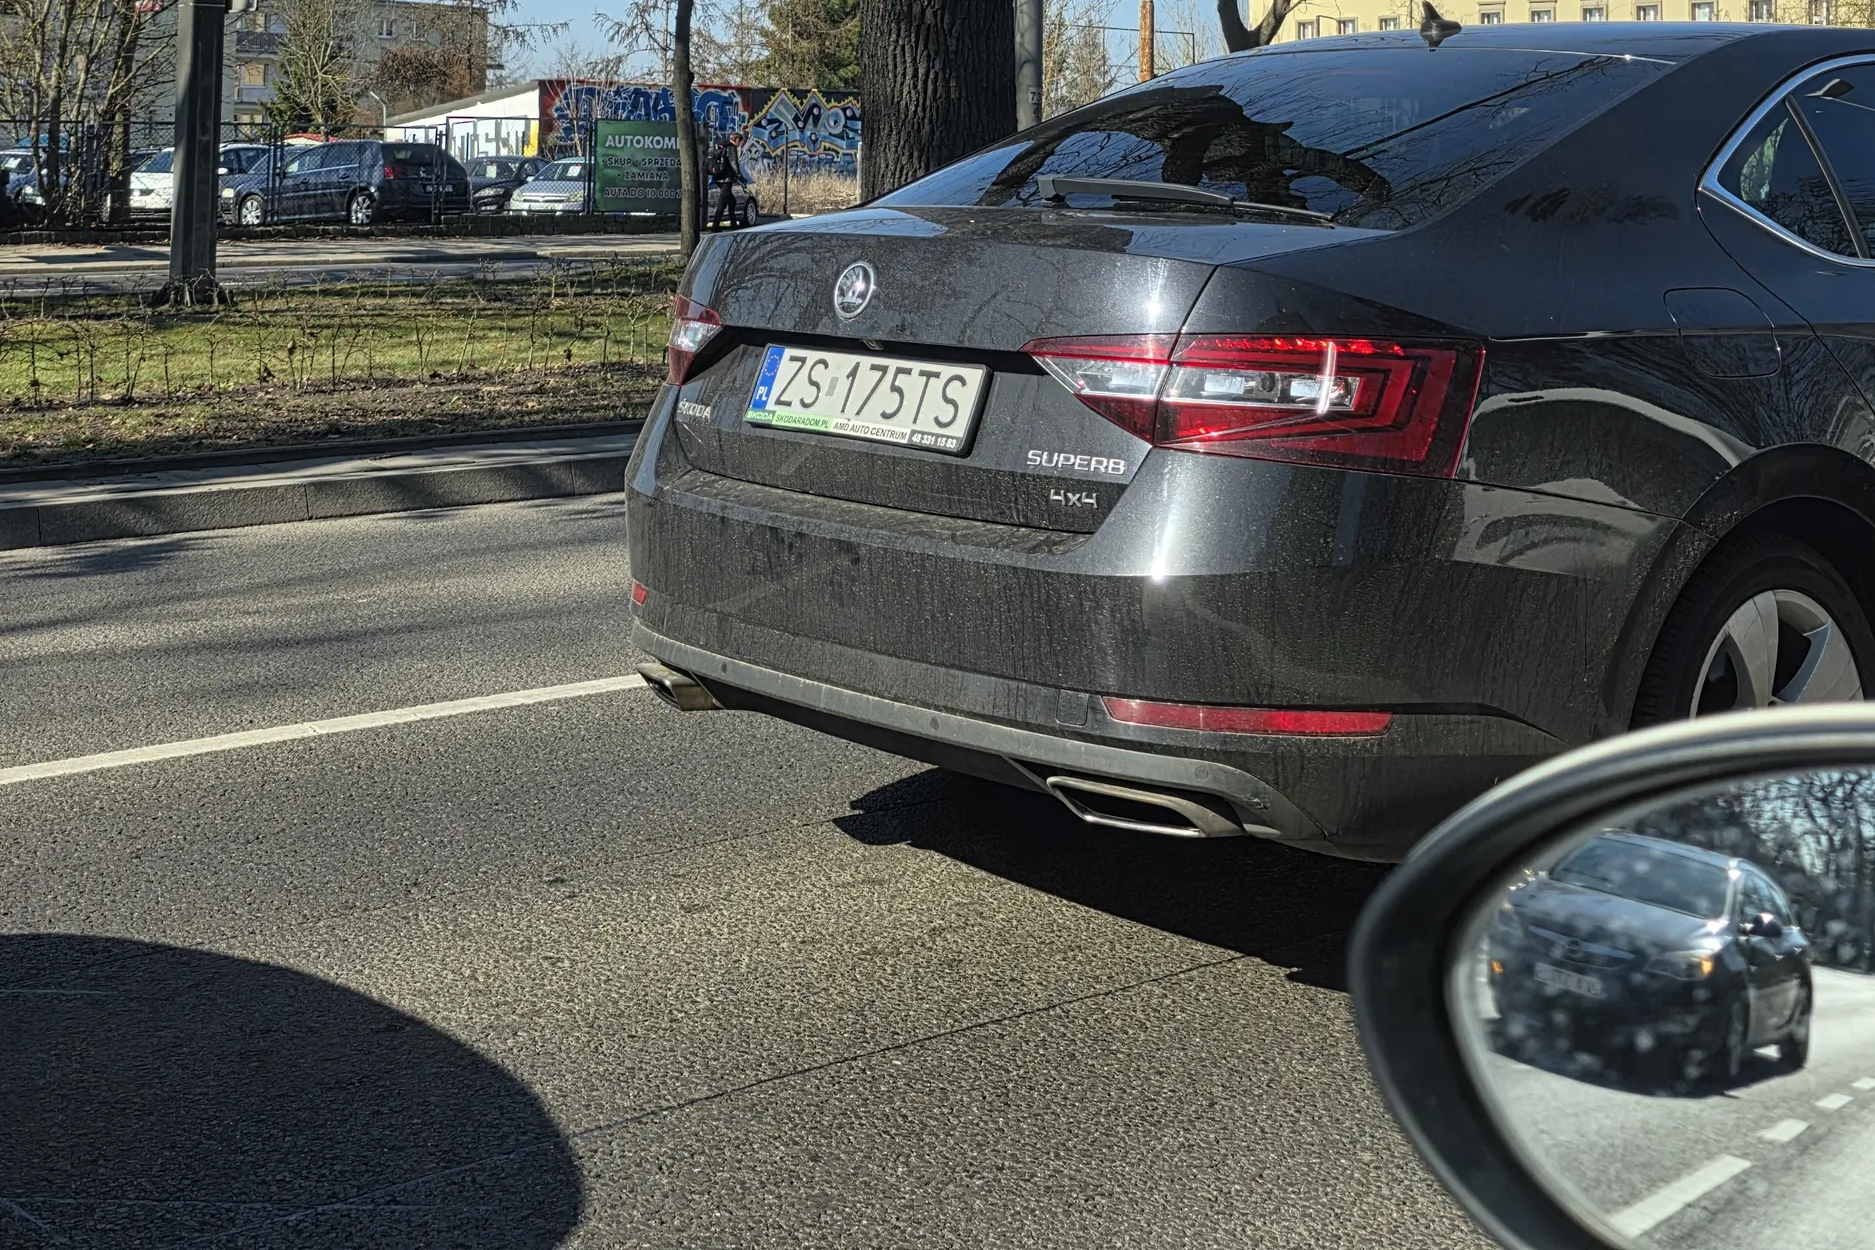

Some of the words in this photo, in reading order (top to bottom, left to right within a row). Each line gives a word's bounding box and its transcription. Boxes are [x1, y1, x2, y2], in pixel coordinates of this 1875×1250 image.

[605, 135, 680, 149] AUTOKOMI
[607, 157, 632, 167] SKUP
[641, 157, 681, 167] SPRZEDA
[624, 171, 669, 181] ZAMIANA
[604, 188, 629, 198] AUTA
[630, 188, 645, 198] DO
[756, 386, 768, 400] PL
[775, 414, 829, 429] SKODARADOM.PL
[833, 421, 850, 431] AMD
[850, 424, 870, 435] AUTO
[870, 427, 907, 441] CENTRUM
[921, 434, 936, 445] 331
[937, 436, 947, 448] 15
[1027, 450, 1125, 474] SUPERB
